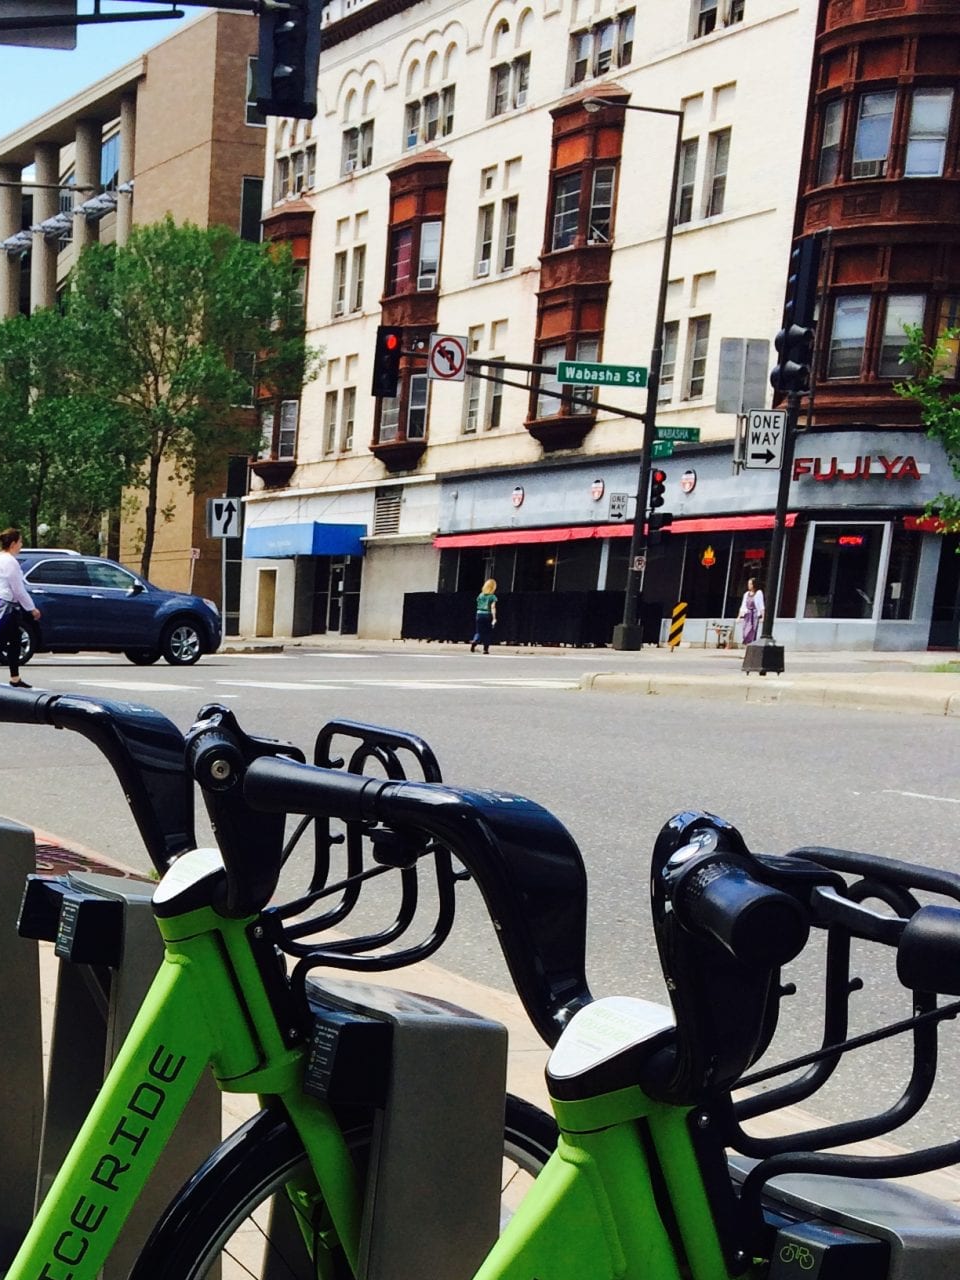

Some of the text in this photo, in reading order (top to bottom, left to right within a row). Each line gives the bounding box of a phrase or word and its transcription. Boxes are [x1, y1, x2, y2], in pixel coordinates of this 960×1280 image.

[565, 366, 641, 383] Wabasha St
[753, 414, 781, 429] ONE
[658, 428, 689, 440] WABASHA
[751, 431, 781, 446] WAY
[611, 495, 625, 503] ONE
[838, 536, 863, 545] OPEN
[91, 1044, 187, 1193] RIDE
